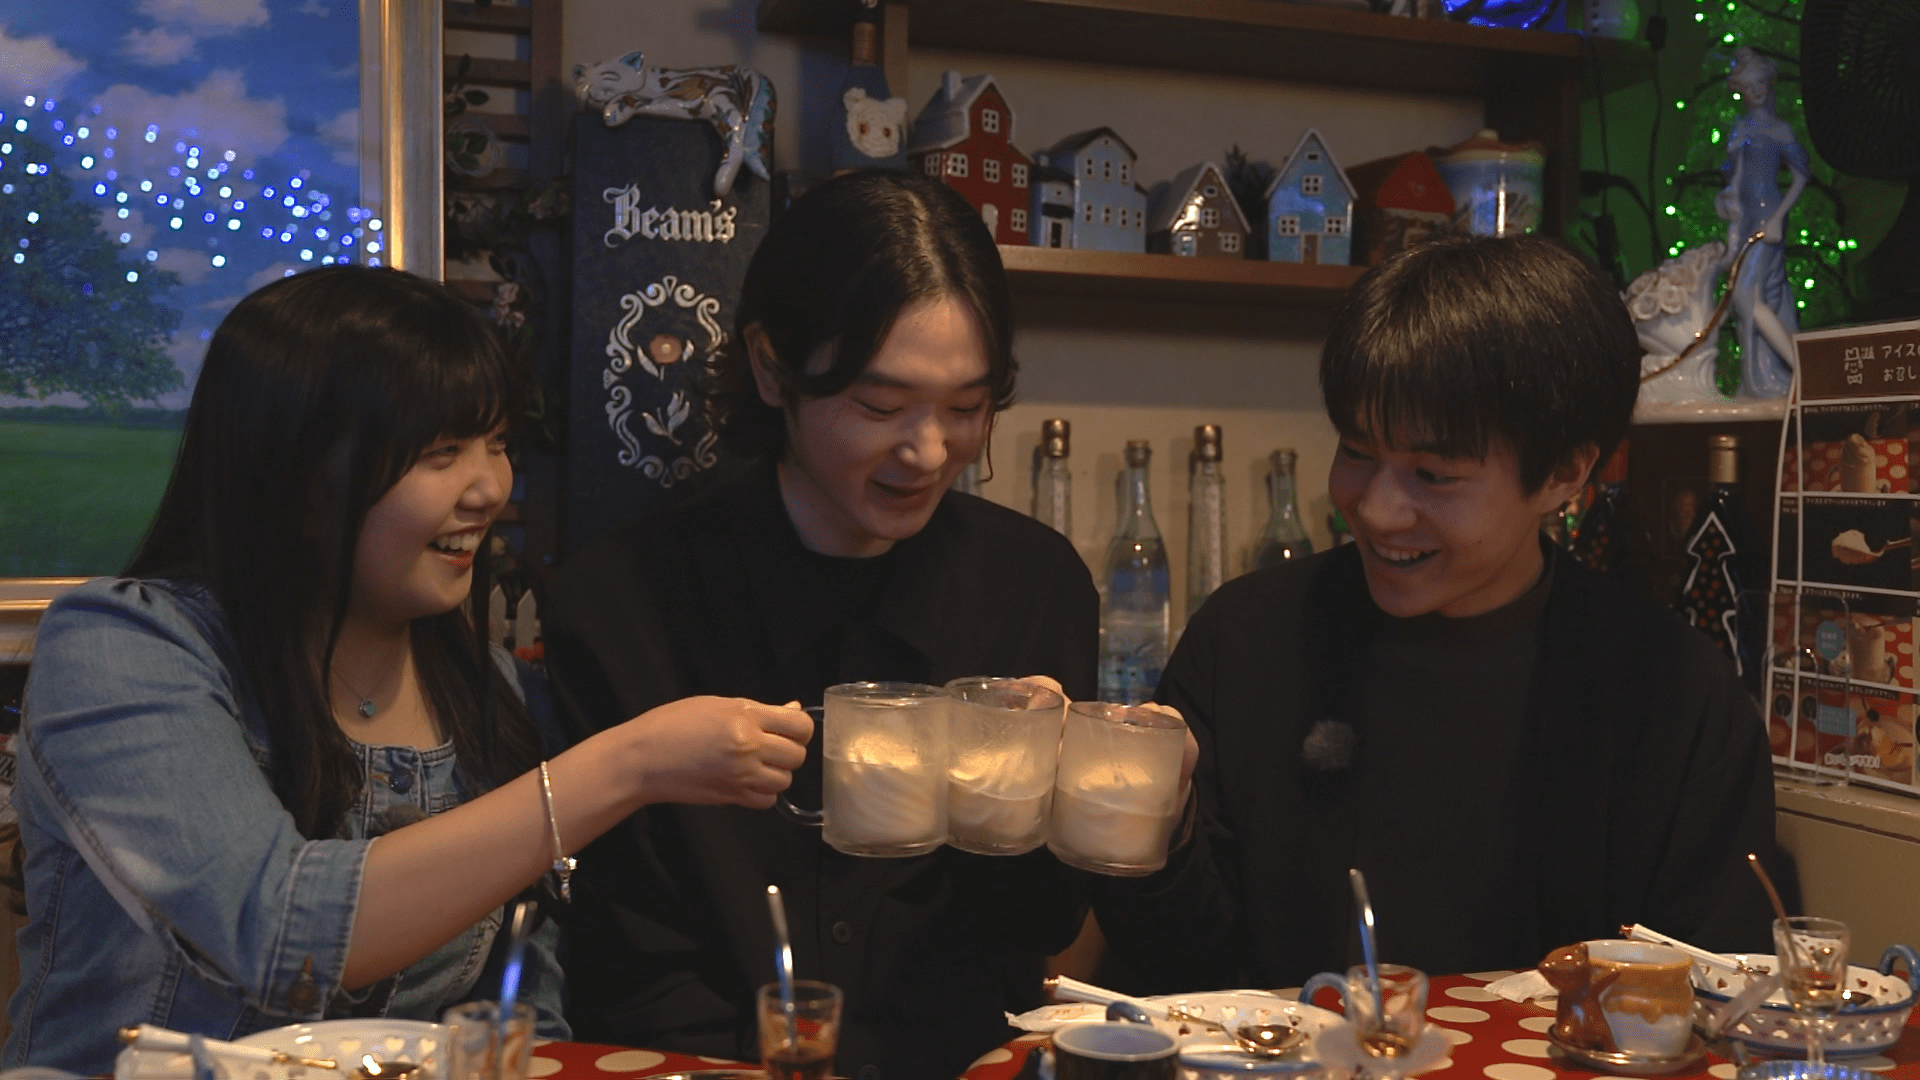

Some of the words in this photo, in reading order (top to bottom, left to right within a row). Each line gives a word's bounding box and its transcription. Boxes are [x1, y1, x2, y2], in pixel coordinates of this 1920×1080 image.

[603, 183, 738, 248] Beam's
[1883, 365, 1917, 382] お召し
